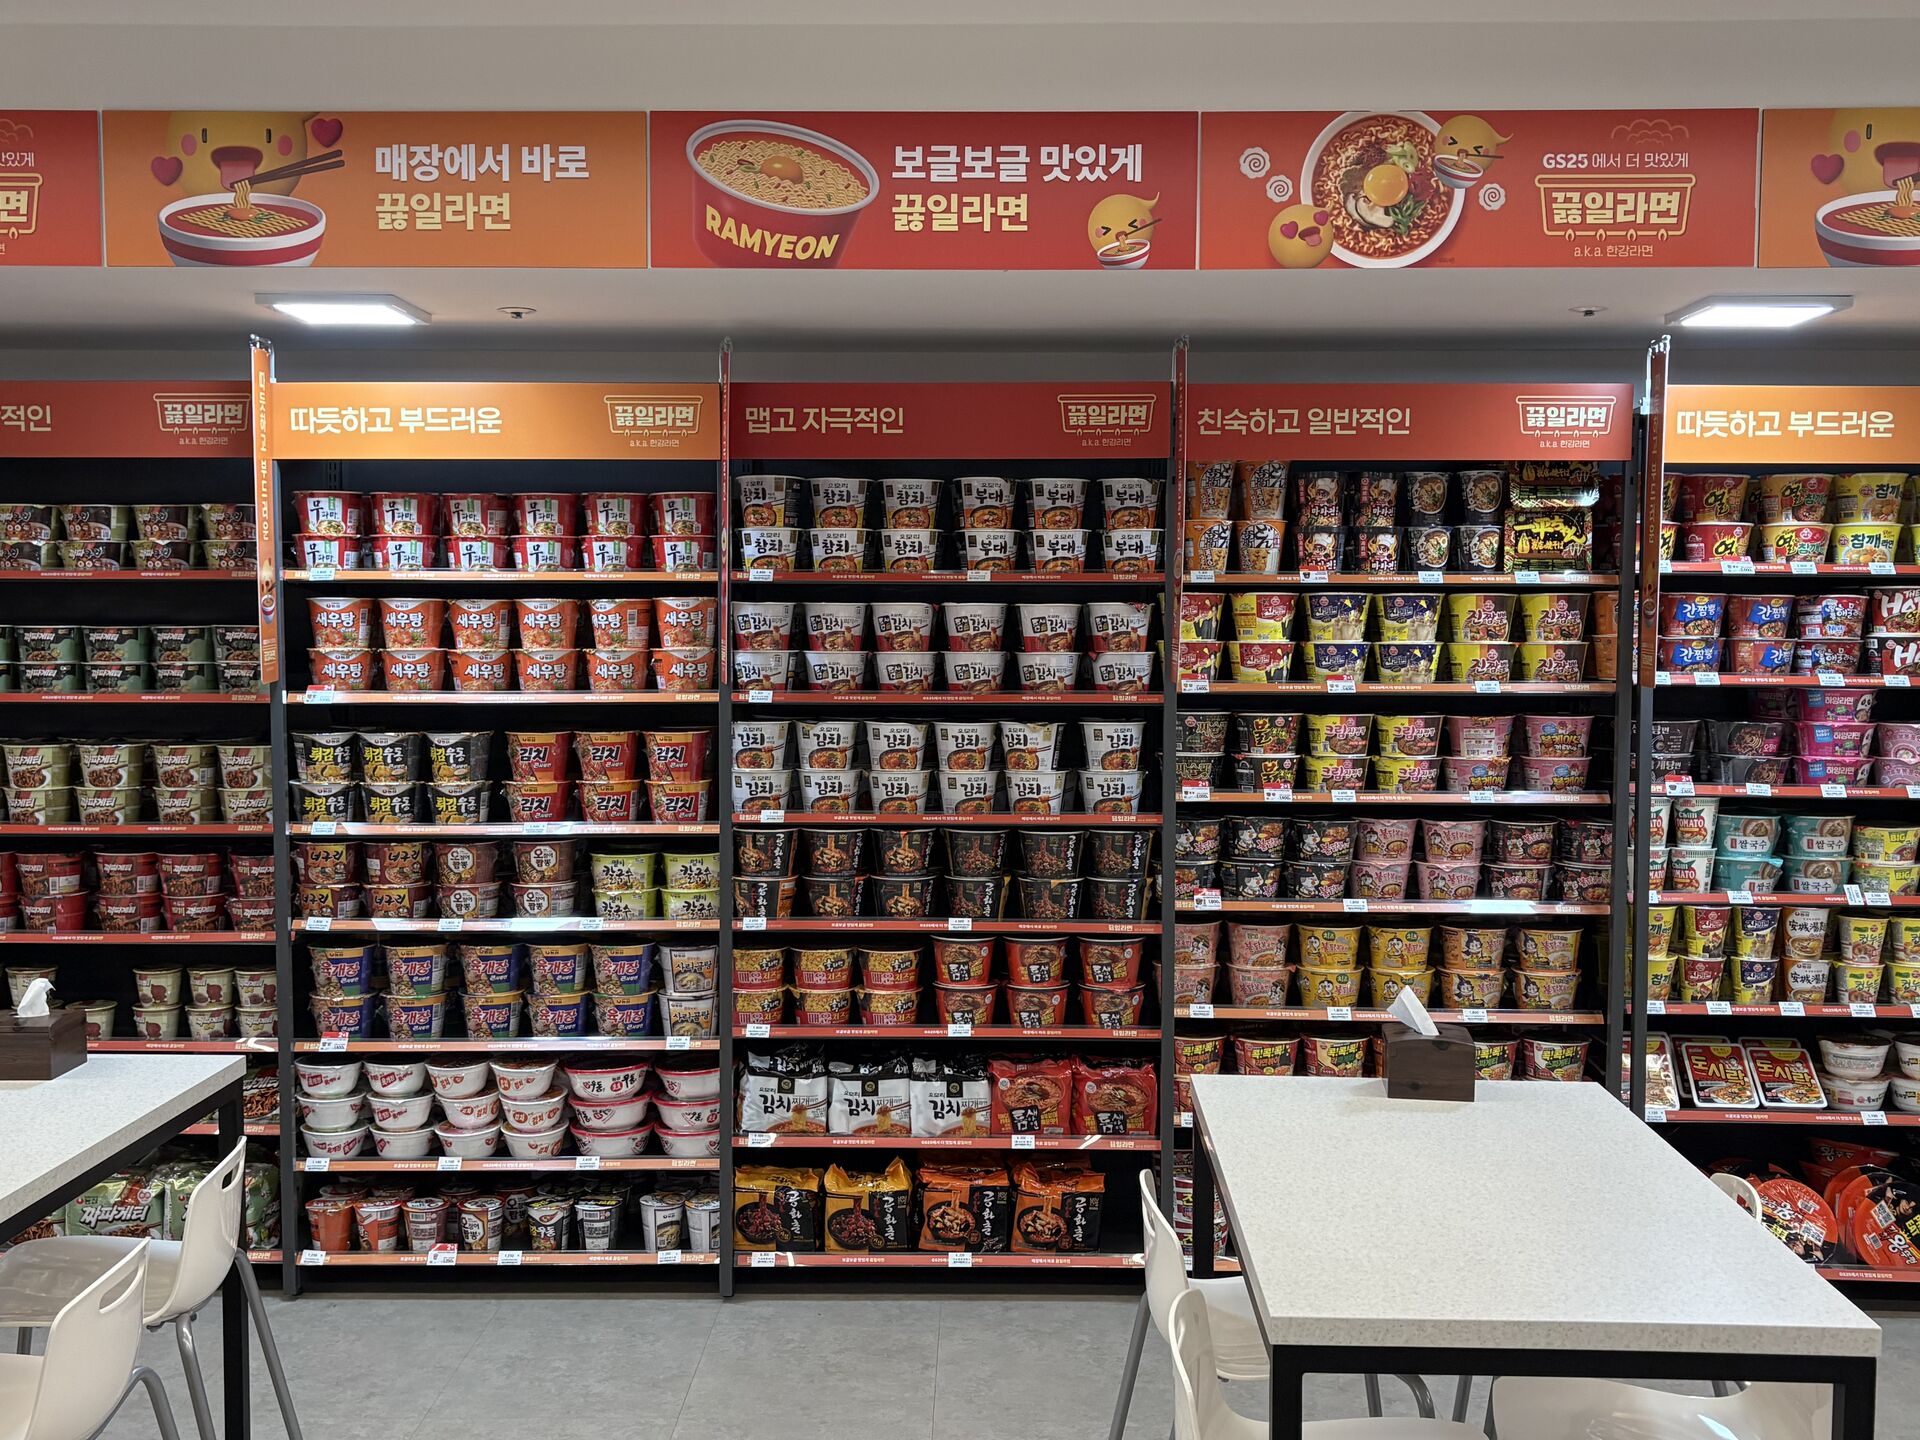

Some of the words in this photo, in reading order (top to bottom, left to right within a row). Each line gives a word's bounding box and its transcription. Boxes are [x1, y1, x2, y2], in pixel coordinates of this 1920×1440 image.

[375, 144, 511, 183] 매장에서
[521, 144, 590, 181] 바로
[891, 145, 1031, 183] 보글보글
[1039, 143, 1143, 183] 맛있게
[1542, 153, 1588, 169] GS25
[1591, 152, 1620, 170] 에서
[1625, 152, 1640, 169] 더
[1644, 150, 1689, 169] 맛있게
[375, 192, 512, 232] 끓일라면
[891, 193, 1030, 233] 끓일라면
[1551, 189, 1680, 226] 끓일라면
[704, 204, 840, 261] RAMYEON
[1606, 244, 1654, 258] 한강라면
[1, 405, 52, 433] 적인
[163, 404, 243, 425] 끓일라면
[291, 406, 393, 436] 따듯하고
[398, 406, 502, 436] 부드러운
[615, 405, 695, 428] 끓일라면
[745, 407, 797, 436] 맵고
[802, 407, 904, 436] 자극적인
[1067, 404, 1148, 427] 끓일라면
[1196, 407, 1302, 436] 친숙하고
[1308, 407, 1411, 437] 일반적인
[1525, 406, 1607, 429] 끓일라면
[1676, 410, 1783, 439] 따듯하고
[1786, 410, 1896, 439] 부드러운
[823, 490, 851, 504] 참치
[896, 490, 924, 505] 참치
[974, 488, 1003, 504] 부대
[1047, 489, 1075, 505] 부대
[1116, 489, 1145, 505] 부대
[316, 612, 356, 629] 새우탕
[386, 612, 424, 628] 새우탕
[523, 612, 562, 629] 새우탕
[664, 611, 704, 628] 새우탕
[751, 617, 772, 630] 김치
[823, 617, 844, 630] 김치
[322, 663, 363, 680] 새우탕
[390, 663, 431, 680] 새우탕
[527, 663, 566, 680] 새우탕
[596, 663, 635, 680] 새우탕
[969, 666, 991, 679] 김치
[1115, 665, 1137, 679] 김치
[738, 733, 765, 748] 김치
[813, 733, 841, 748] 김치
[883, 734, 912, 749] 김치
[952, 734, 980, 749] 김치
[519, 746, 549, 763] 김치
[591, 746, 621, 762] 김치
[656, 746, 686, 762] 김치
[882, 782, 910, 797] 김치
[1015, 783, 1042, 797] 김치
[1097, 783, 1125, 798] 김치
[521, 796, 551, 813] 김치
[596, 795, 627, 812] 김치
[1675, 818, 1704, 828] TOMATO
[1738, 839, 1768, 850] 쌀국수
[1815, 838, 1844, 850] 쌀국수
[1890, 832, 1905, 842] BIG
[1896, 870, 1911, 880] BIG
[1800, 881, 1832, 892] 쌀국수
[320, 960, 360, 977] 육개장
[392, 959, 431, 976] 육개장
[536, 959, 575, 976] 육개장
[602, 958, 640, 976] 육개장
[321, 1010, 360, 1027] 육개장
[607, 1007, 645, 1025] 육개장
[1690, 1056, 1747, 1087] 도시락
[1756, 1058, 1813, 1089] 도시락
[758, 1094, 792, 1115] 김치
[843, 1098, 876, 1117] 김치
[928, 1099, 961, 1120] 김치
[79, 1205, 149, 1229] 짜파게티
